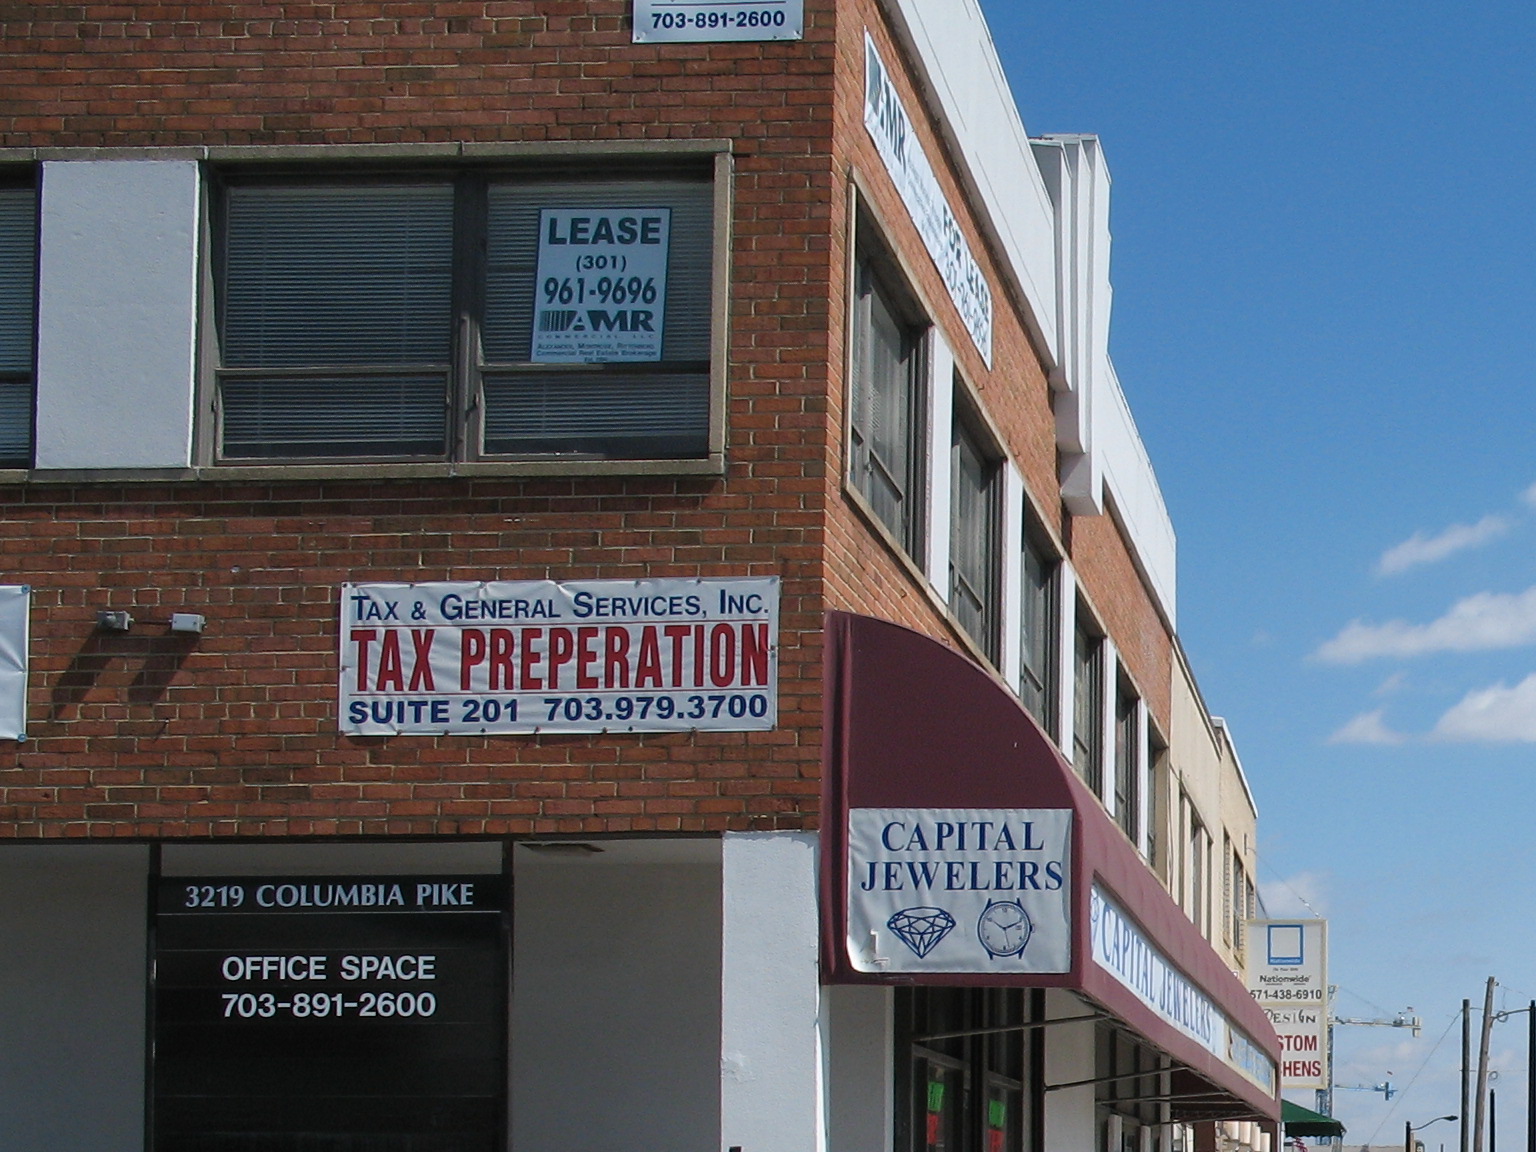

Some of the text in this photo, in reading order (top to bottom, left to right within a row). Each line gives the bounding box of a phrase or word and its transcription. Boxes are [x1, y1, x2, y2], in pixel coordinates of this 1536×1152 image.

[652, 11, 785, 29] 703-891-2600
[548, 217, 661, 245] LEASE
[576, 255, 627, 272] (301)
[544, 277, 657, 305] 961-9696
[351, 588, 769, 621] TAX & GENERAL SERVICES, INC.
[350, 622, 769, 692] TAX PREPERATION
[348, 694, 768, 724] SUITE 201 703.979.3700
[881, 821, 1045, 852] CAPITAL
[861, 860, 1064, 892] JEWELERS
[184, 883, 474, 908] 3219 COLUMBIA PIKE
[221, 955, 437, 981] OFFICE SPACE
[1102, 902, 1212, 1045] CAPITAL JEWELERS
[1259, 974, 1310, 983] Nationwide
[221, 992, 437, 1018] 703-891-2600
[1250, 988, 1323, 1001] 571-438-6910
[1277, 1034, 1318, 1052] STOM
[1282, 1060, 1322, 1078] HENS
